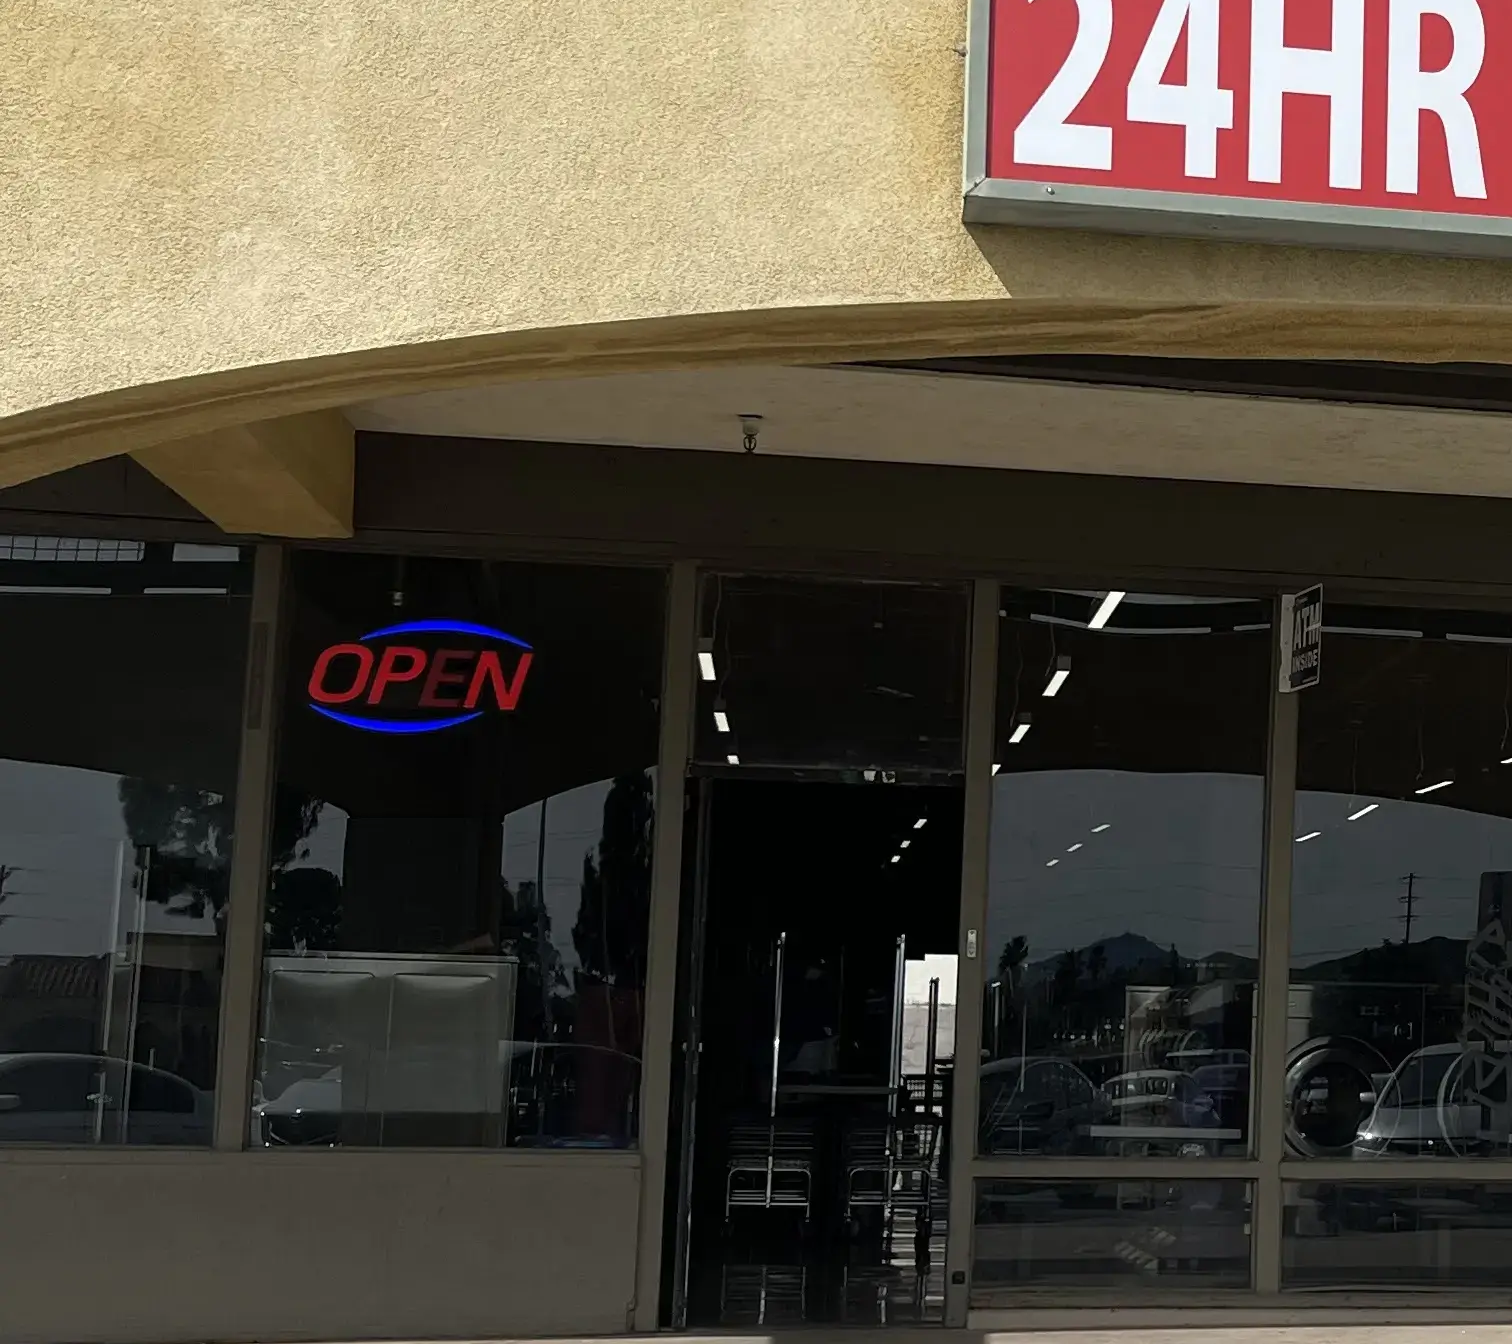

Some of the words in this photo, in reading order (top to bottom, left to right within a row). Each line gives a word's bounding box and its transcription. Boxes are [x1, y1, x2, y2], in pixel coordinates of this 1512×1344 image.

[1294, 602, 1320, 650] ATM
[307, 641, 534, 712] OPEN
[1292, 649, 1318, 673] INSIDE
